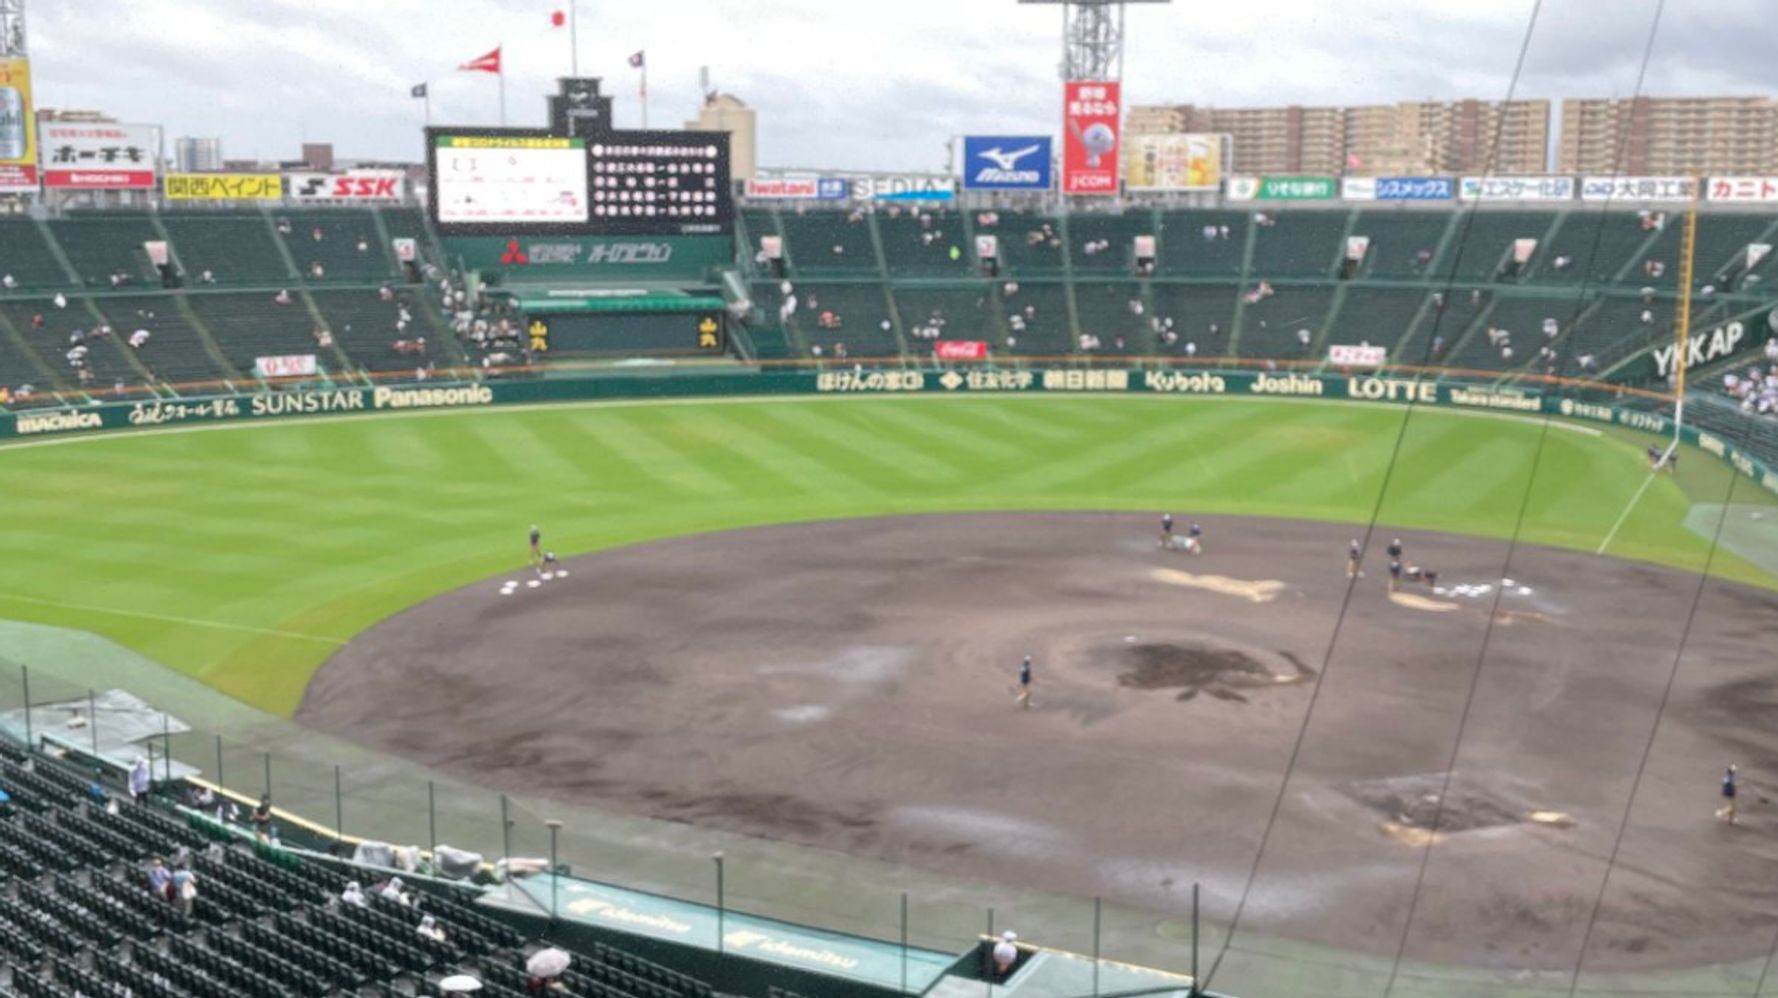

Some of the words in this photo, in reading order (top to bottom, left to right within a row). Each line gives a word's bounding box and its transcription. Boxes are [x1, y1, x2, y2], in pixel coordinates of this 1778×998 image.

[52, 145, 144, 163] ホーチキ
[167, 178, 279, 196] 関西ペイント
[332, 178, 398, 196] SSK
[750, 179, 815, 196] Iwatani
[1267, 181, 1328, 197] りそな銀行
[1377, 180, 1449, 199] シスメックス
[1484, 179, 1570, 197] エスケー化研
[1712, 180, 1776, 198] カニト
[1043, 370, 1128, 389] 朝日新聞
[1145, 370, 1225, 393] Kubota
[1250, 372, 1323, 395] Joshin
[373, 382, 493, 408] Panasonic
[1349, 377, 1438, 402] LOTTE
[251, 390, 364, 416] SUNSTAR
